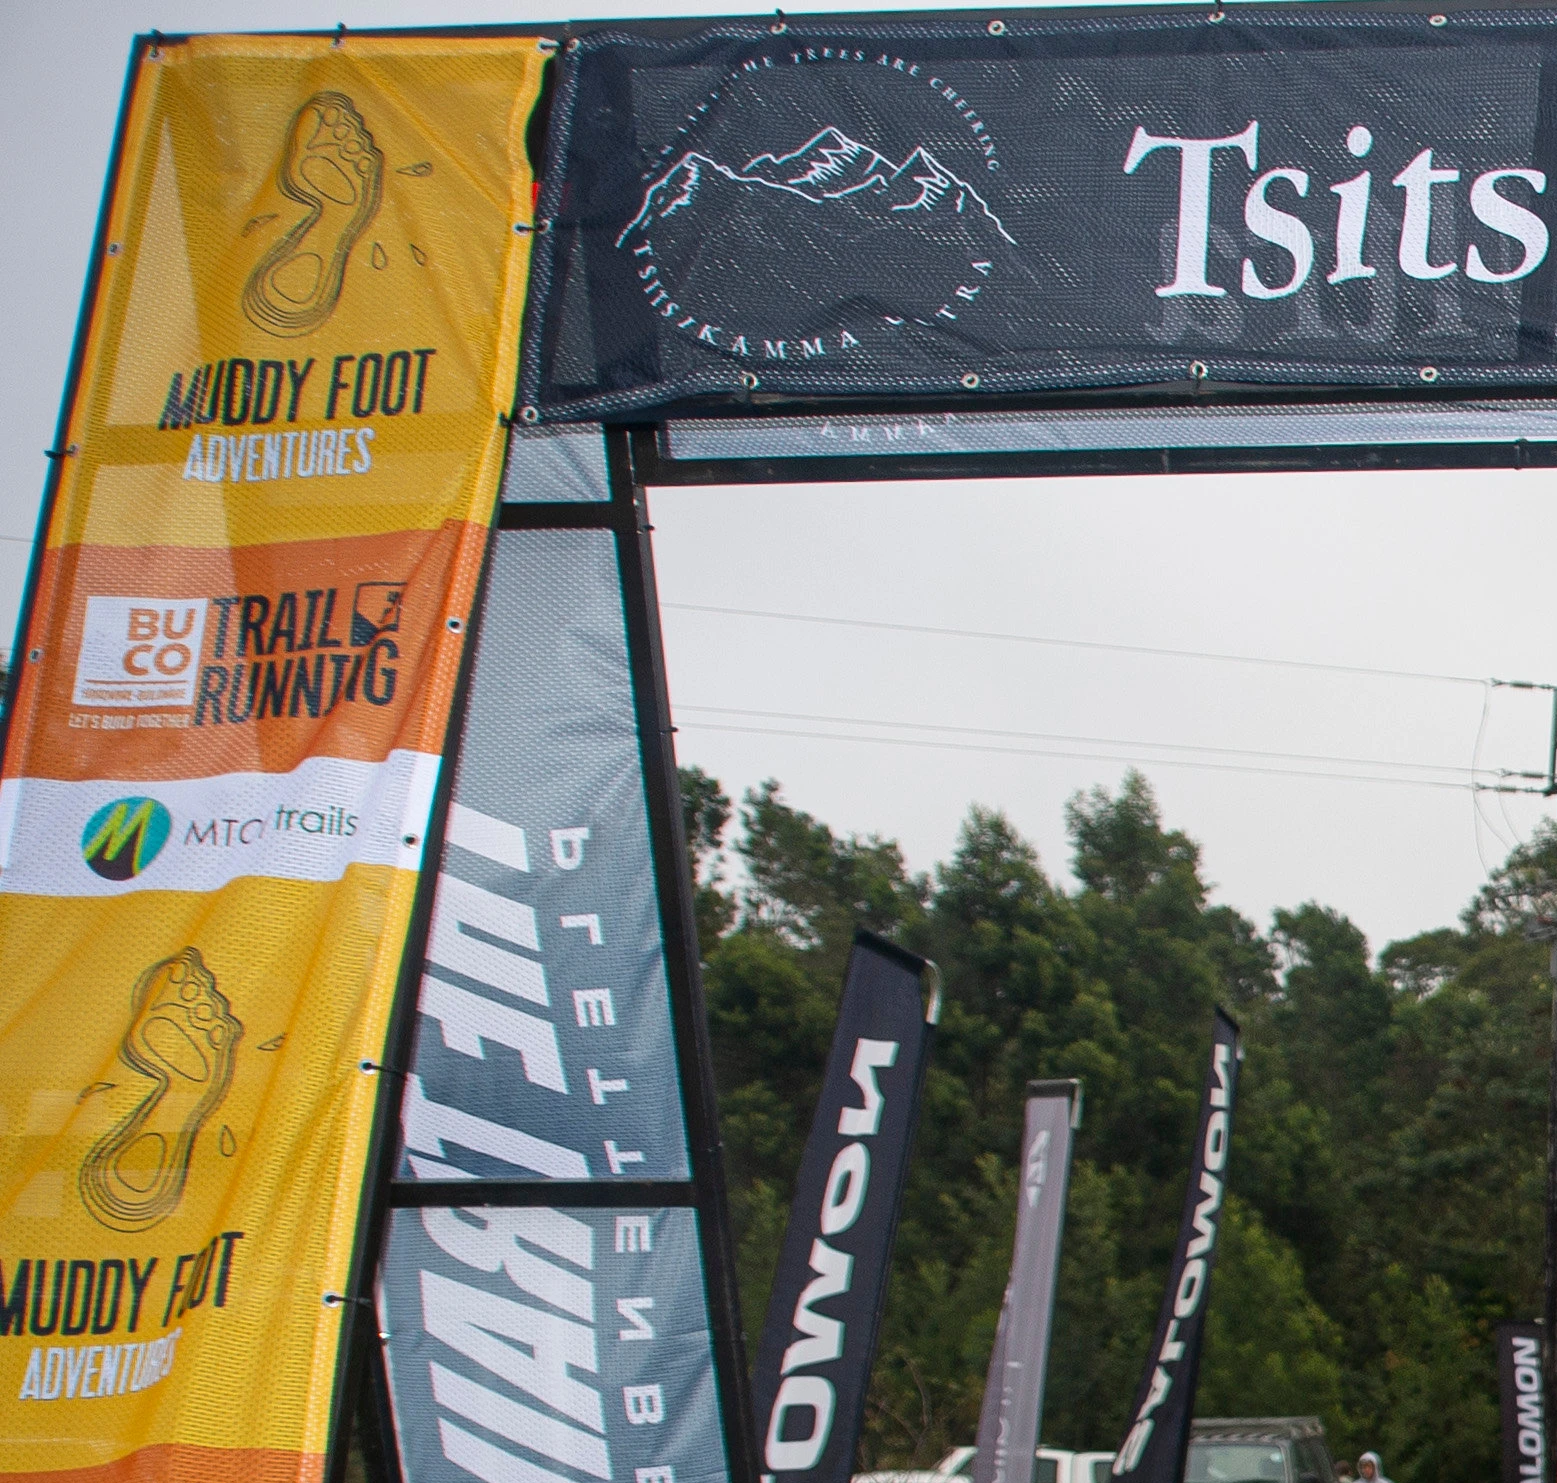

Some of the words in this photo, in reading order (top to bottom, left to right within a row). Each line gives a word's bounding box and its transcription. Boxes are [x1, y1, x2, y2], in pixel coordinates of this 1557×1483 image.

[877, 52, 921, 77] ARE
[928, 76, 1000, 172] CHEERING
[632, 239, 860, 360] TSITSIKAMMA
[157, 357, 316, 431] MUDDY
[323, 348, 437, 420] FOOT
[181, 427, 376, 483] ADVENTURES
[127, 607, 197, 642] BU
[212, 588, 342, 661] TRAIL
[122, 642, 193, 677] CO
[274, 804, 359, 837] trails
